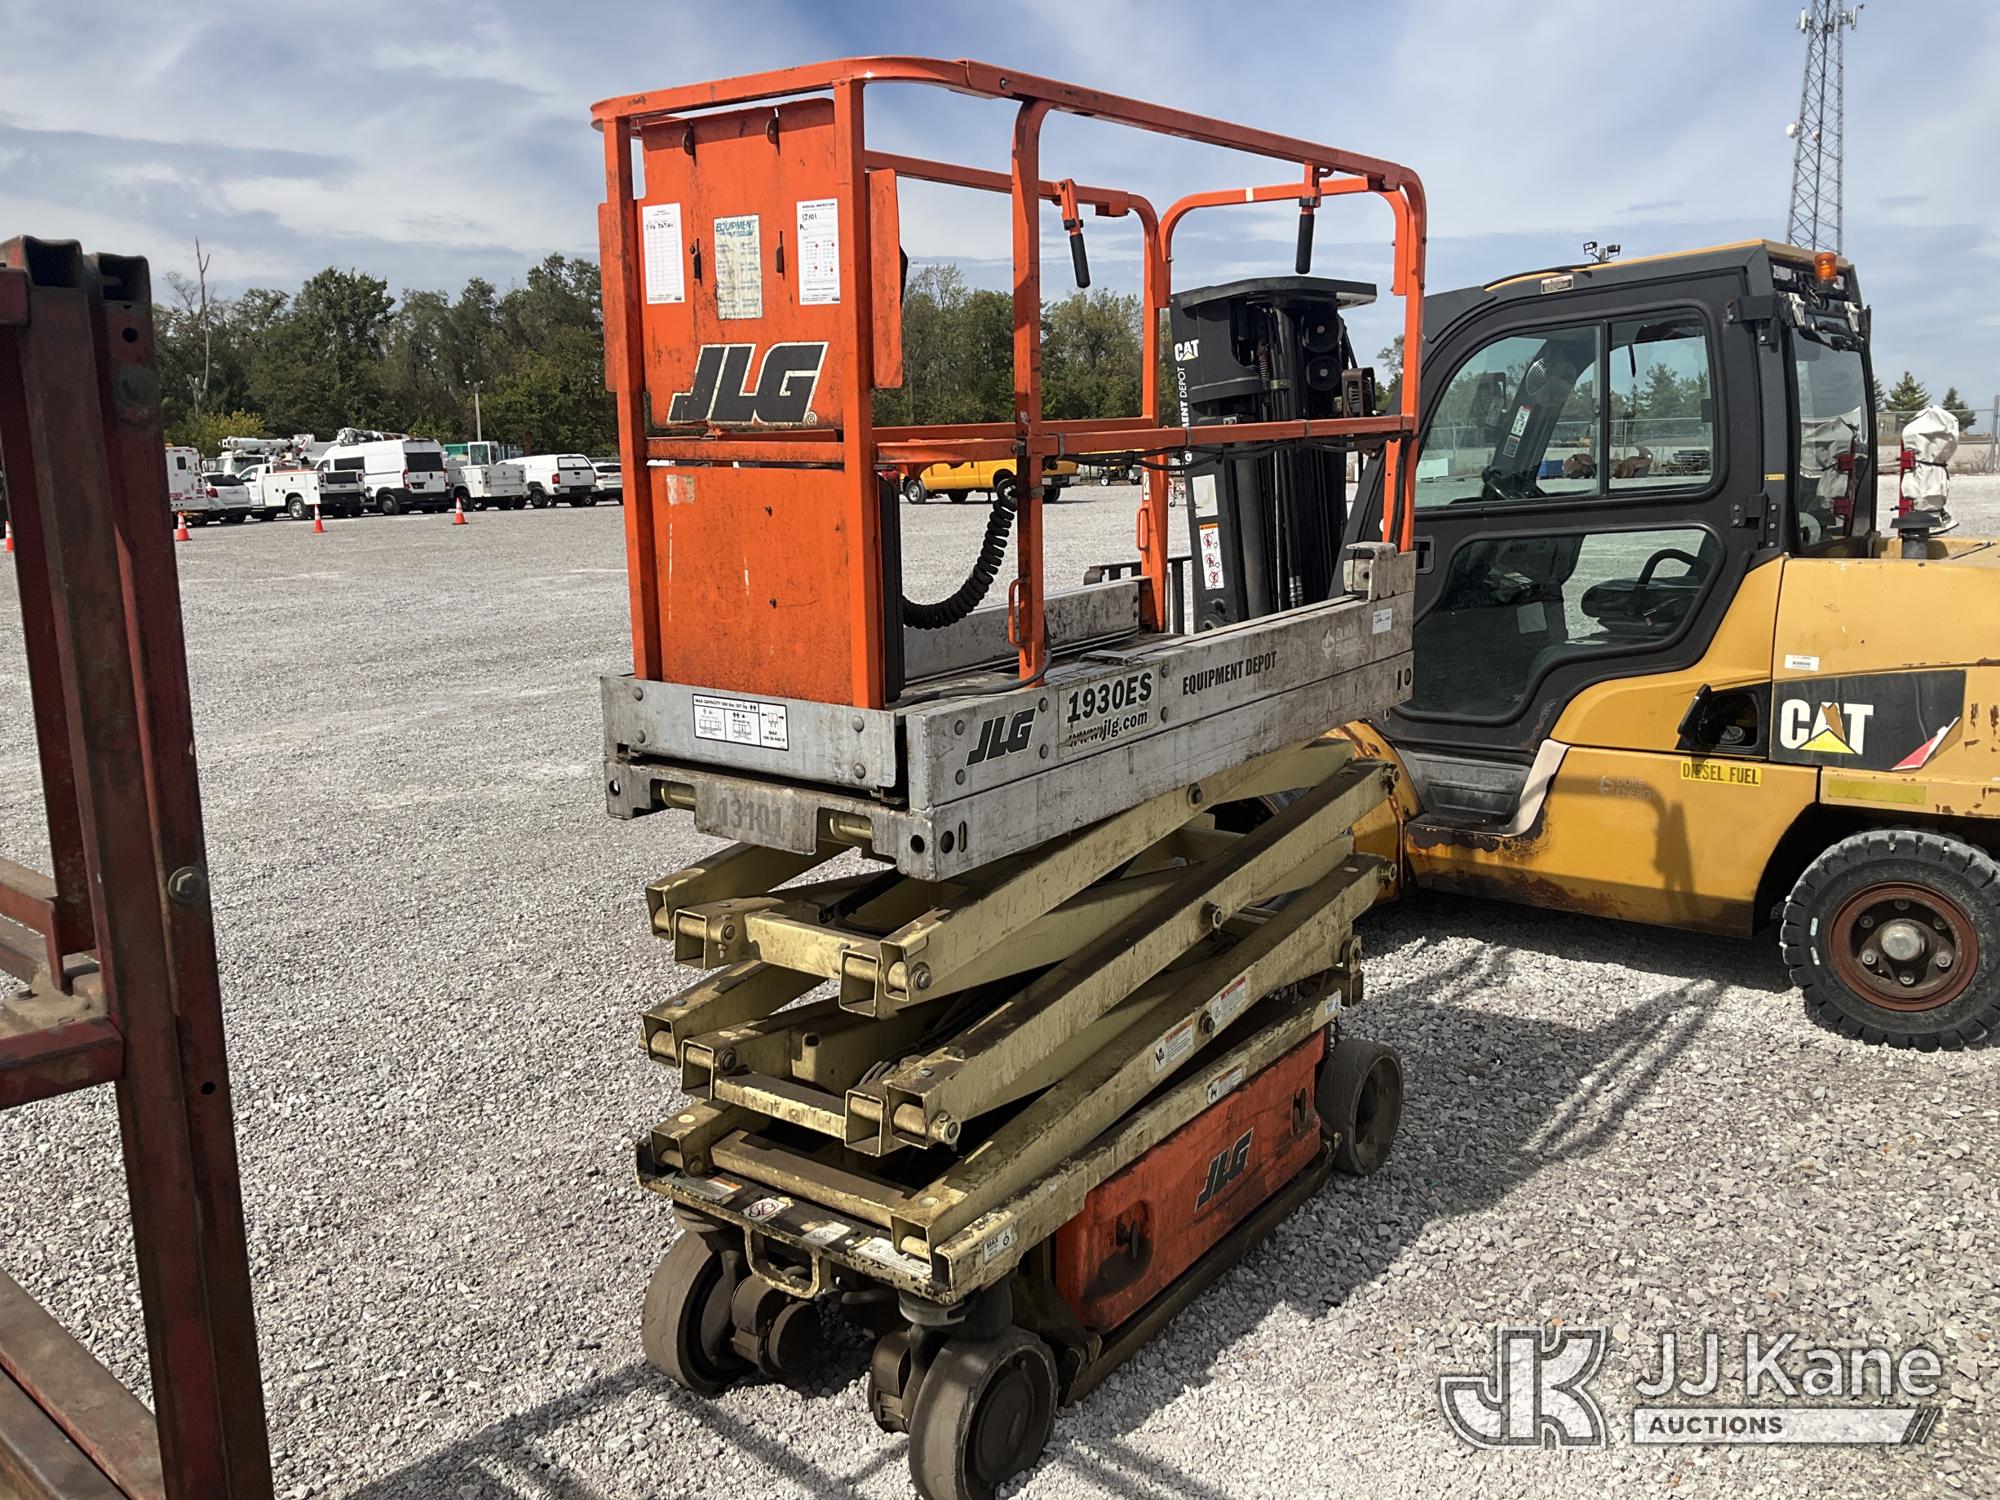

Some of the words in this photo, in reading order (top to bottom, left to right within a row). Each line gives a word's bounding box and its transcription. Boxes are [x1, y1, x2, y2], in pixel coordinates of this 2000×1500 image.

[1174, 339, 1199, 361] CAT
[667, 341, 829, 425] JLG
[1177, 366, 1188, 398] DEPOT
[1067, 672, 1152, 723] 1930ES
[1182, 660, 1244, 695] EQUIPMENT
[1245, 651, 1277, 677] DEPOT
[965, 706, 1037, 768] JLG
[1780, 698, 1874, 755] CAT
[1682, 763, 1725, 781] DIESEL
[1729, 766, 1759, 785] FUEL
[1194, 1127, 1254, 1213] JLG
